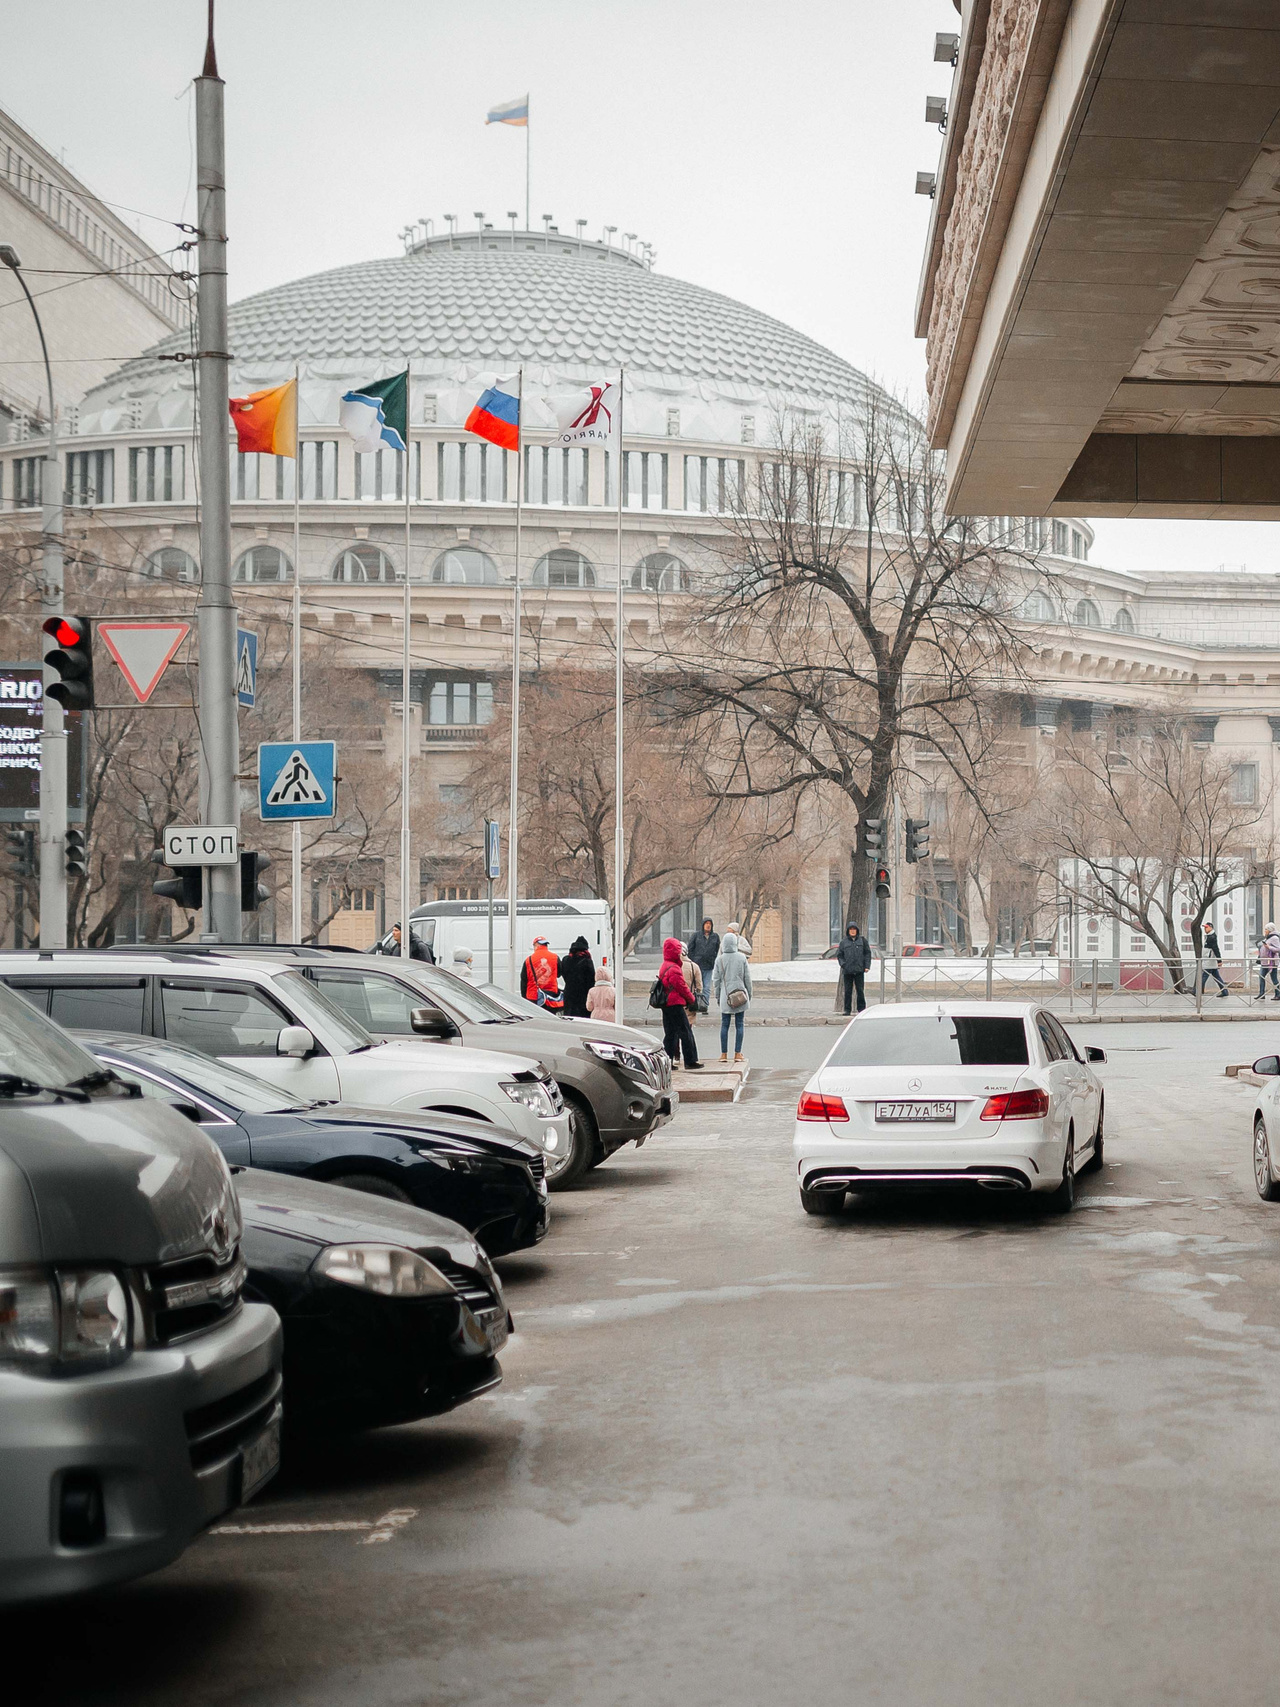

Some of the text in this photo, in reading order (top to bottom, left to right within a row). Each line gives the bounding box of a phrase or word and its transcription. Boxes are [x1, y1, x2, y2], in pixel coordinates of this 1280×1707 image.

[169, 835, 233, 855] СТОП
[880, 1103, 952, 1117] Е777УА 154
